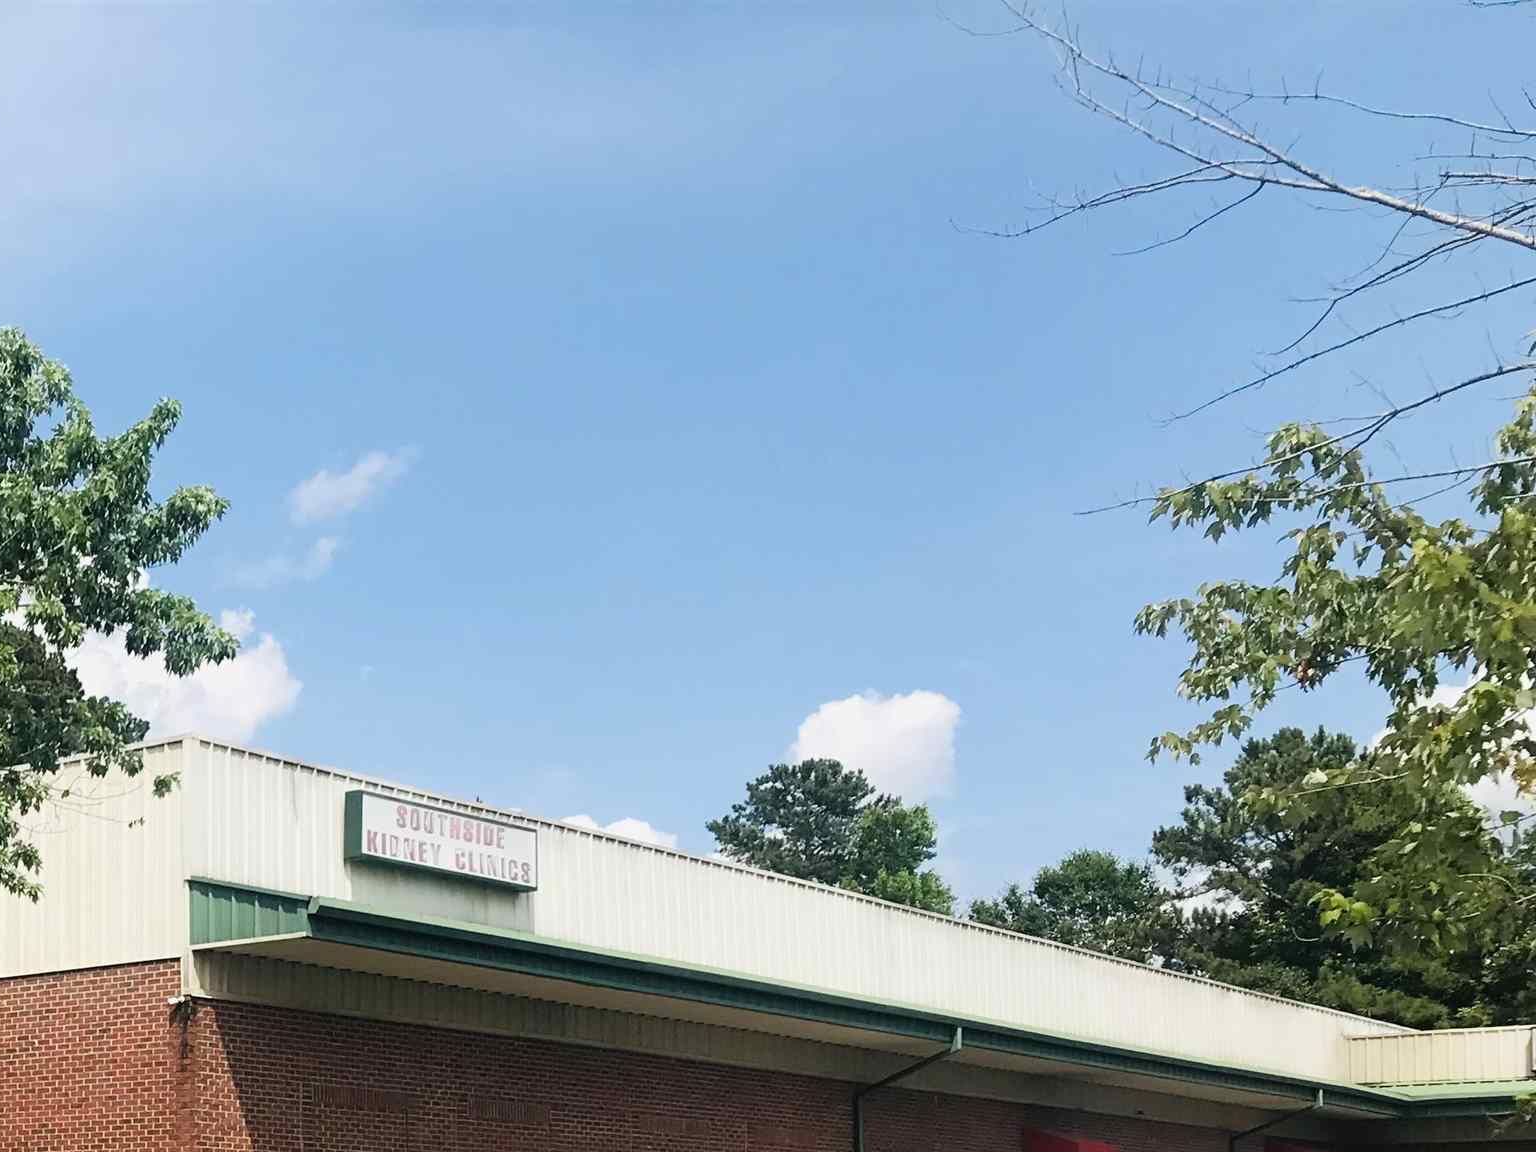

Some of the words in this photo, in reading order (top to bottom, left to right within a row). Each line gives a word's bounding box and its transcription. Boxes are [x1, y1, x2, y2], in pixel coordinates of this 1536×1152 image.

[396, 805, 505, 849] SOUTHSIDE
[367, 830, 441, 866] KIDNEY
[455, 850, 531, 884] CLINICS
